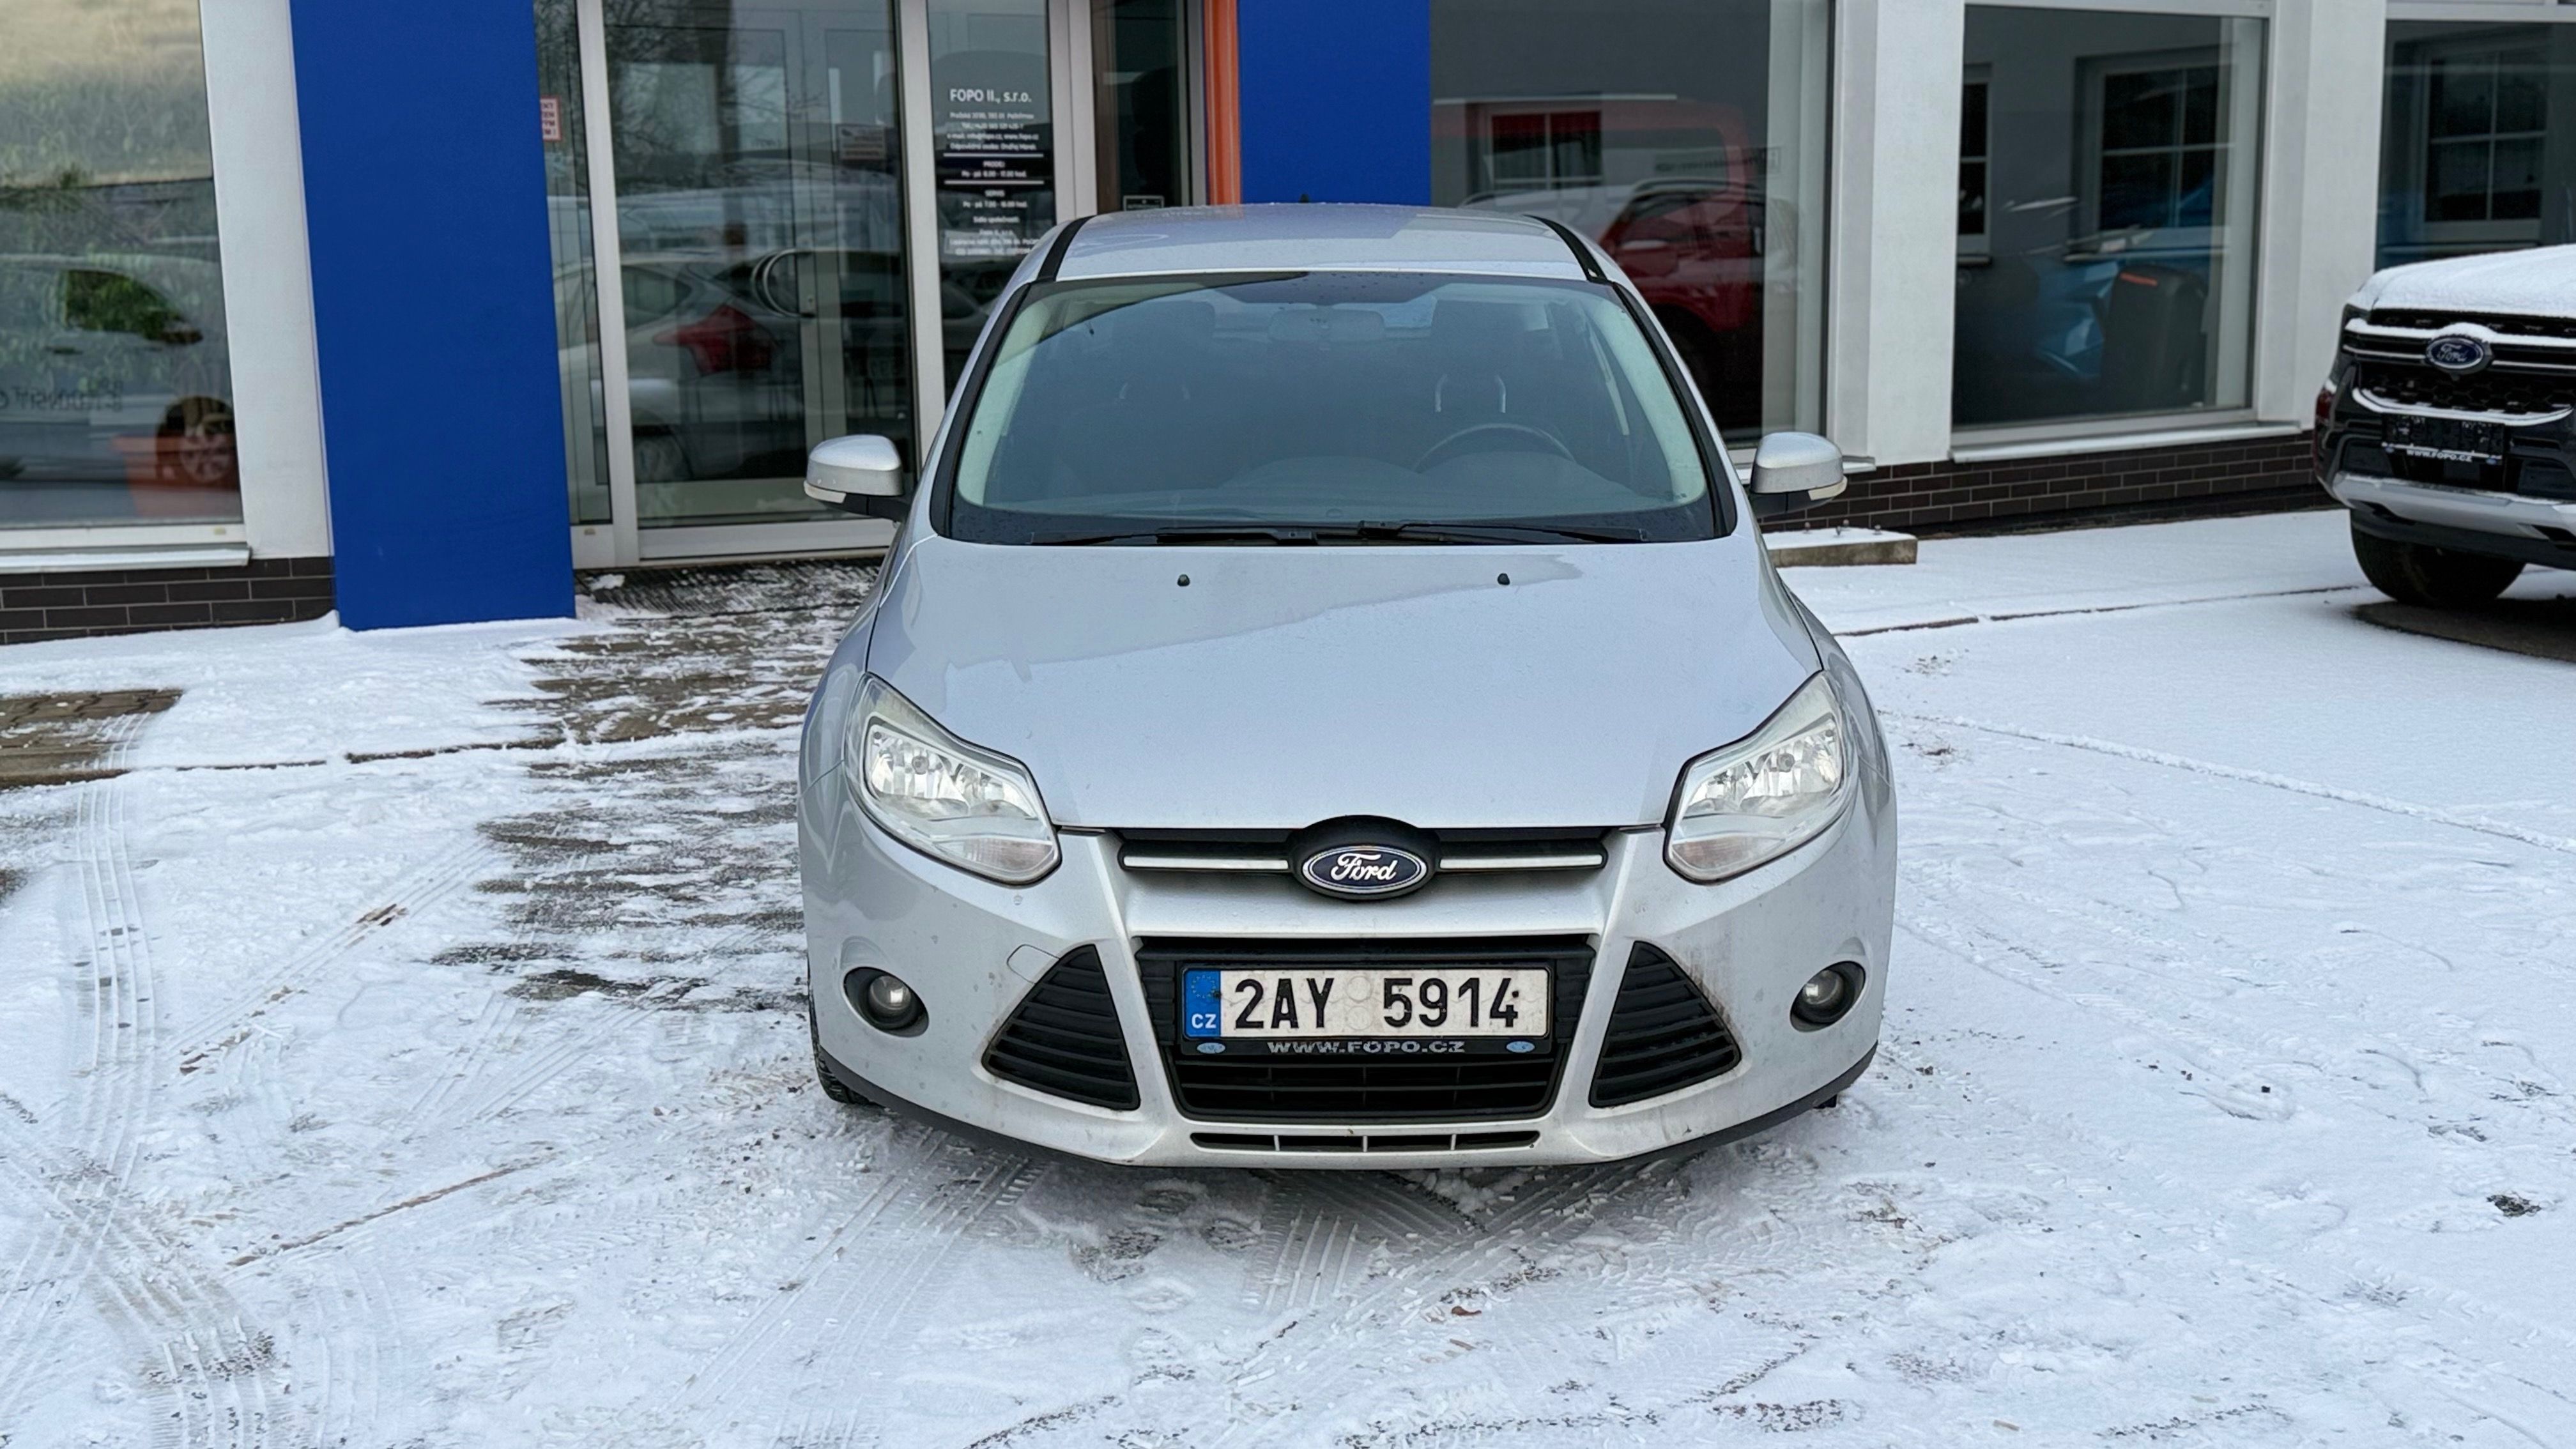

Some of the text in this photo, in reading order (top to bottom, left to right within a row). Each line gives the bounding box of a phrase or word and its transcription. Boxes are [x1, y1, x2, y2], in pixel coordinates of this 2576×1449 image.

[949, 88, 984, 102] FOPO
[1003, 91, 1032, 103] s.r.o.
[2436, 343, 2467, 362] Ford
[2407, 448, 2472, 463] WWW.FOPO.CZ
[1331, 853, 1398, 881] Ford
[1234, 977, 1519, 1030] 2AY 5914
[1191, 1013, 1216, 1029] CZ
[1267, 1041, 1465, 1054] WWW.FOPO.CZ
